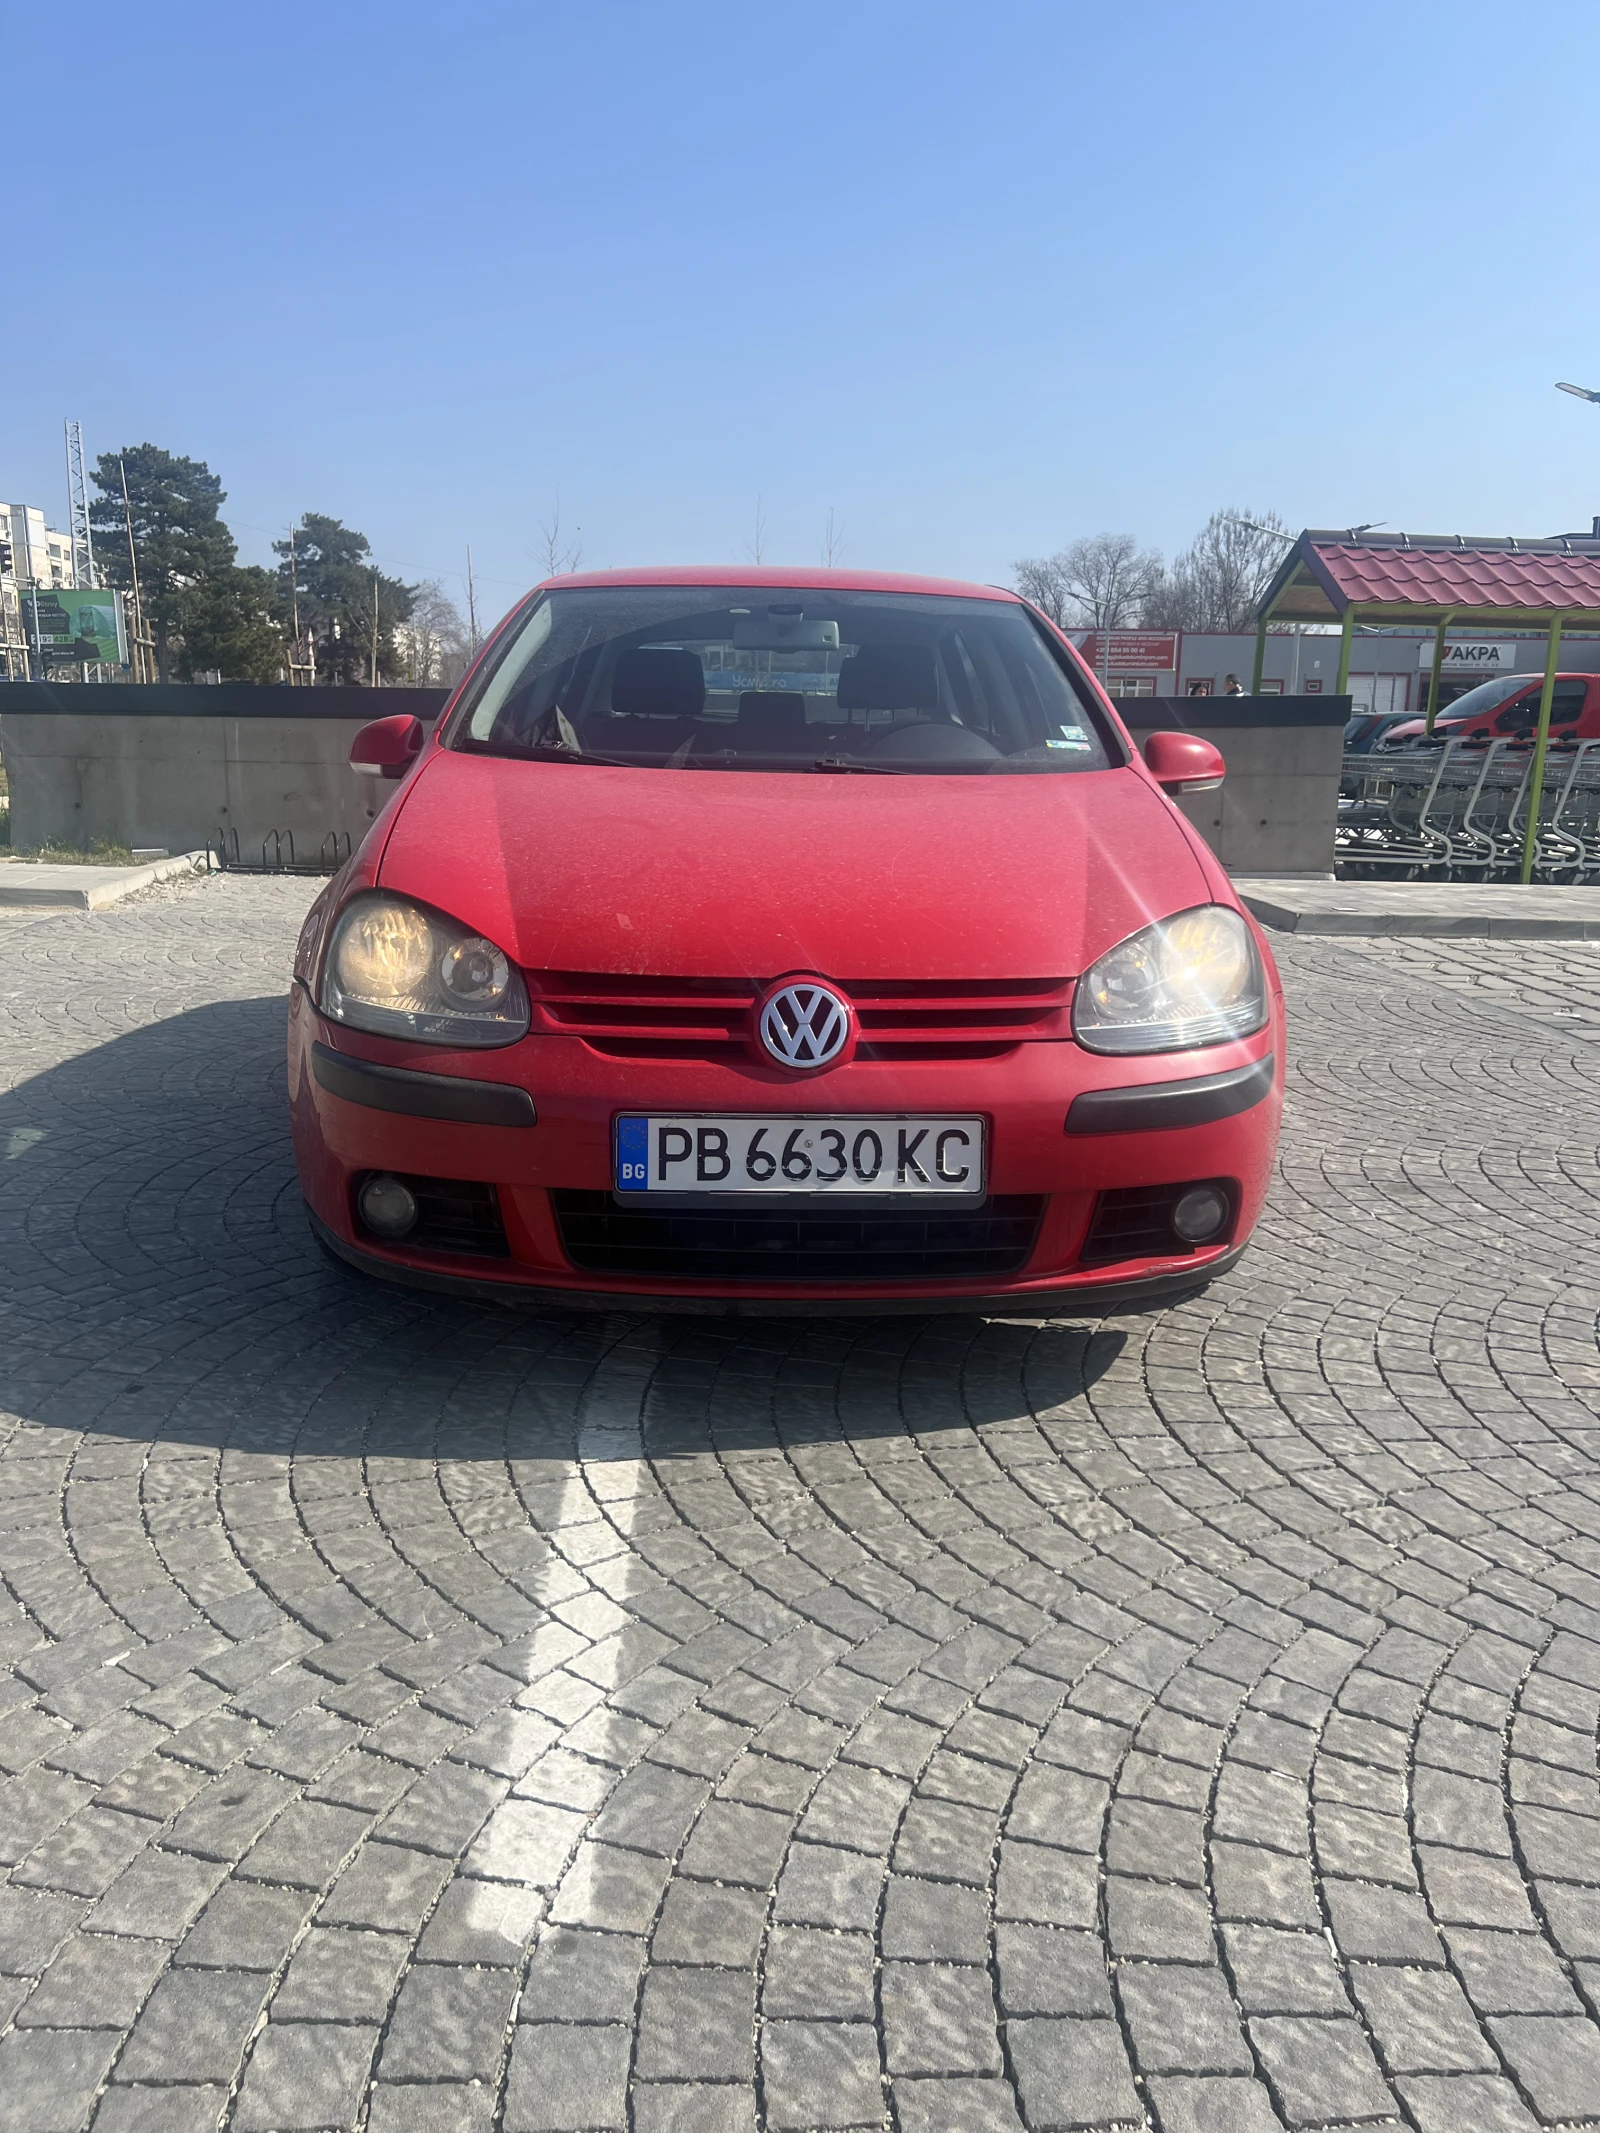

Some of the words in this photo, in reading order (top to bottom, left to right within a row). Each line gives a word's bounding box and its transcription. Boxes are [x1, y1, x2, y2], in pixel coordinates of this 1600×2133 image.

[1451, 646, 1500, 661] AKPA
[658, 1127, 731, 1182] PB
[746, 1128, 883, 1182] 6630
[897, 1128, 970, 1183] KC
[622, 1163, 645, 1180] BG
